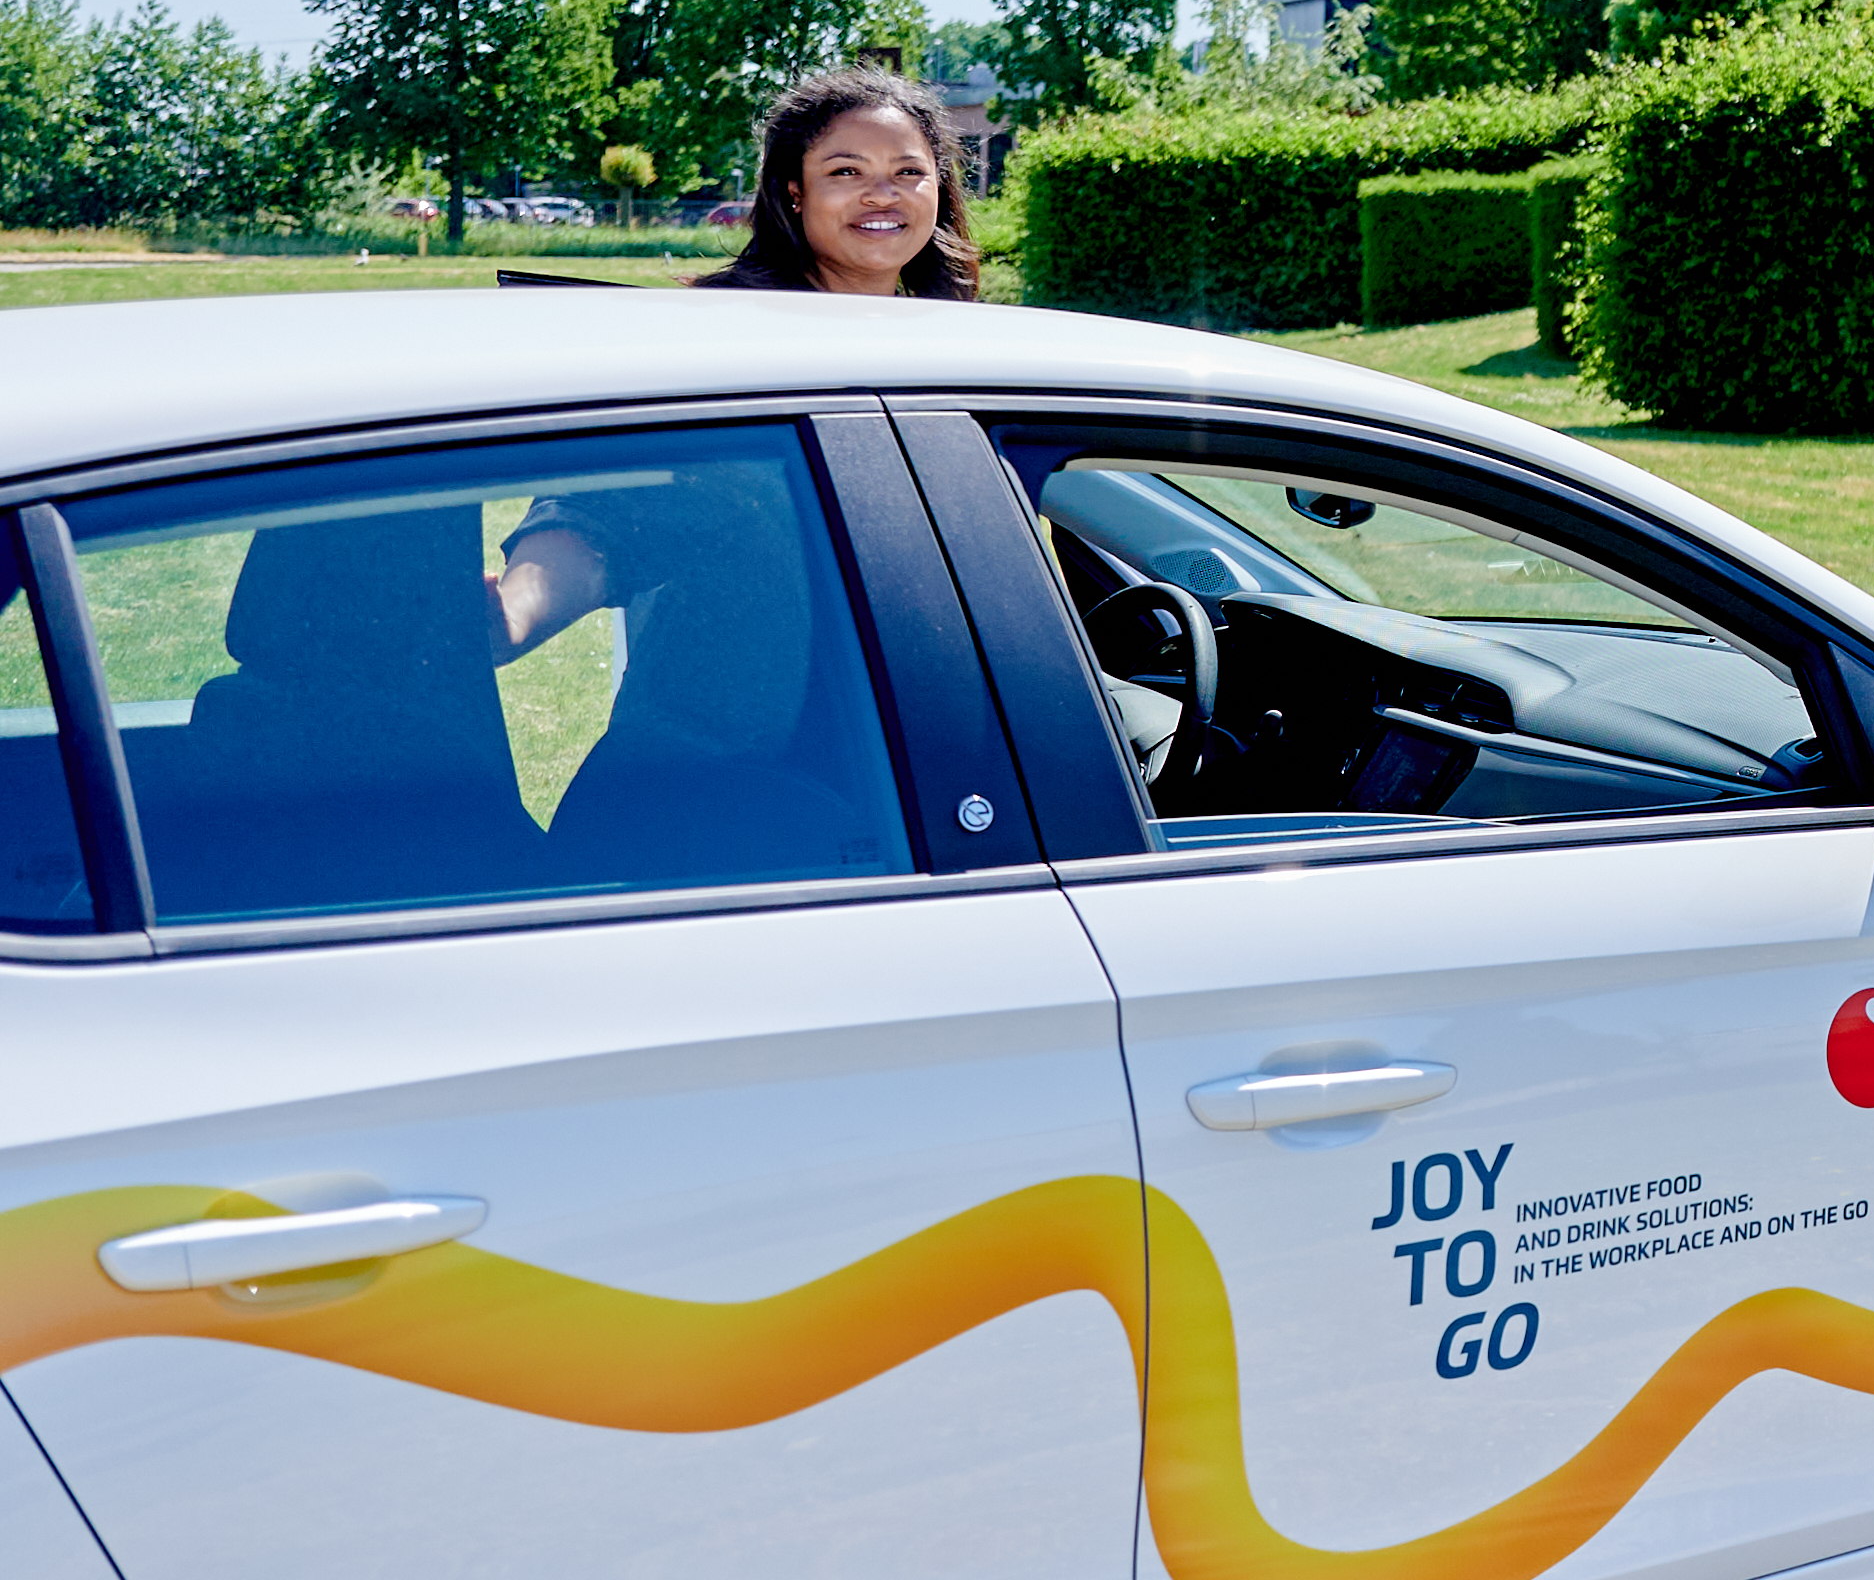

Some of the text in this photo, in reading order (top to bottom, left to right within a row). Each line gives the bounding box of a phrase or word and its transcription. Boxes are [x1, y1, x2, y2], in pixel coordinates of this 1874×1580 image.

[1371, 1142, 1515, 1230] JOY
[1515, 1194, 1753, 1254] AND DRINK SOLUTIONS:
[1516, 1173, 1702, 1222] INNOVATIVE FOOD
[1393, 1229, 1496, 1306] TO
[1514, 1200, 1869, 1284] IN THE WORKPLACE AND ON THE GO
[1436, 1301, 1539, 1380] GO
